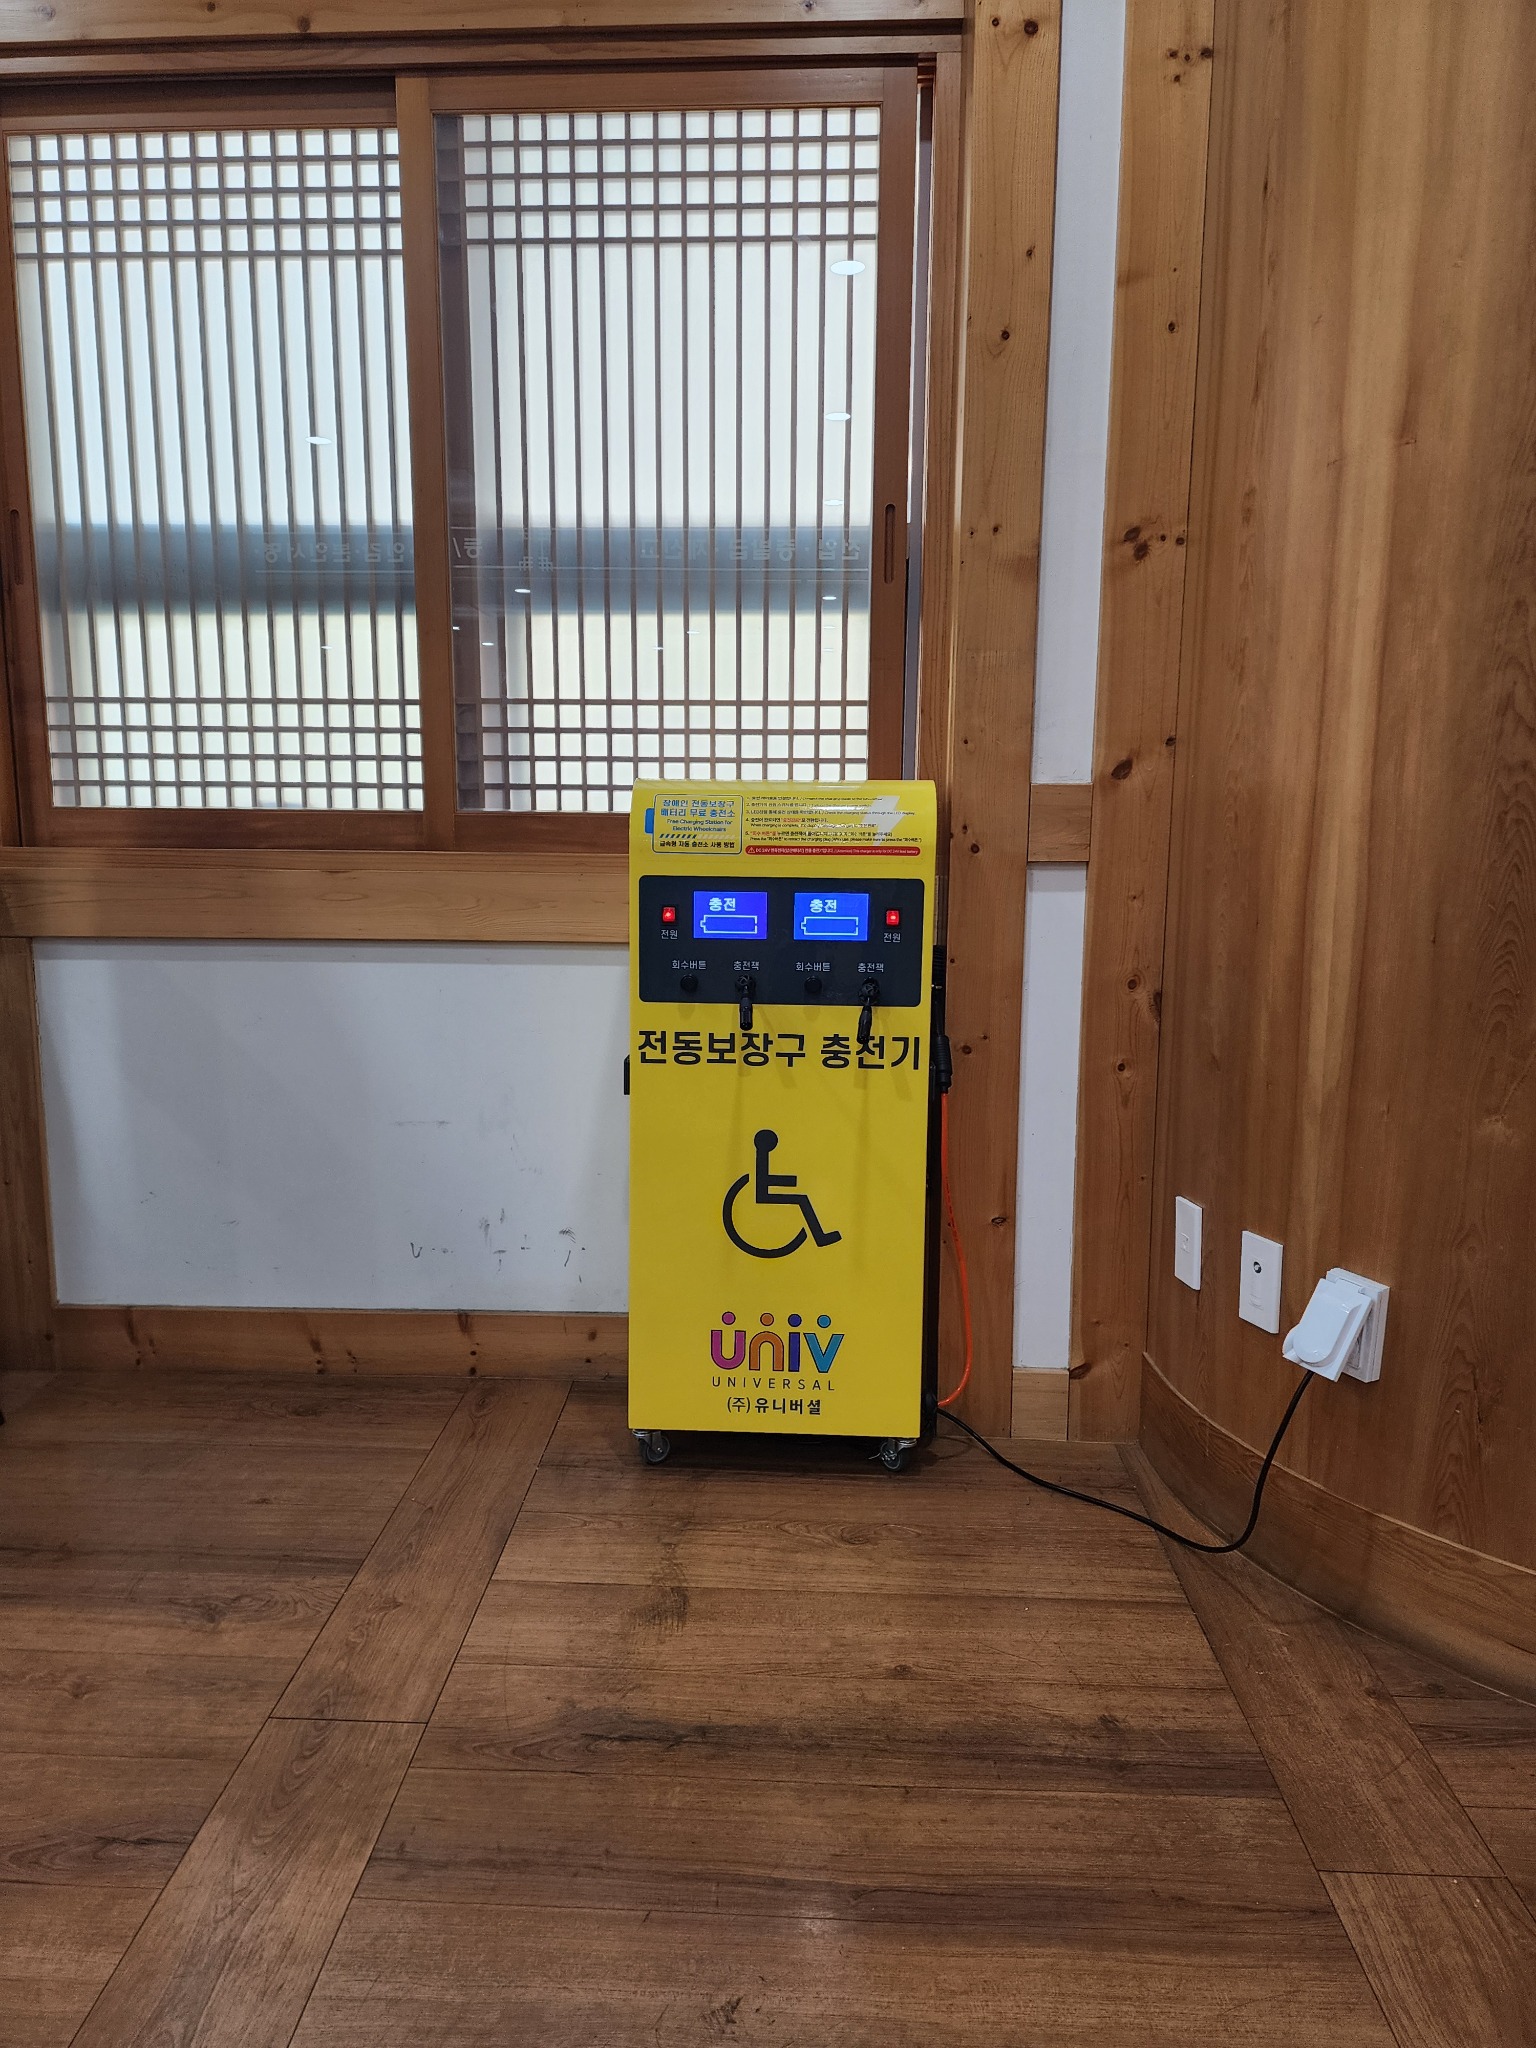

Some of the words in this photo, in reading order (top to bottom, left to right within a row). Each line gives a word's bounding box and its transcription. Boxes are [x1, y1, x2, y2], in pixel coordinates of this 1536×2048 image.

[663, 799, 689, 807] 장애인
[692, 800, 735, 808] 전동보장구
[661, 808, 687, 817] 배터리
[690, 809, 707, 817] 무료
[710, 809, 735, 818] 충전소
[709, 897, 736, 912] 충전
[810, 899, 837, 913] 충전
[661, 929, 678, 940] 전원
[884, 932, 901, 943] 전원
[672, 960, 707, 970] 회수버튼
[733, 961, 760, 971] 충전잭
[796, 962, 831, 972] 회수버튼
[858, 963, 884, 973] 충전잭
[638, 1030, 806, 1068] 전동보장구
[820, 1034, 920, 1070] 충전기
[712, 1376, 835, 1391] UNIVERSAL
